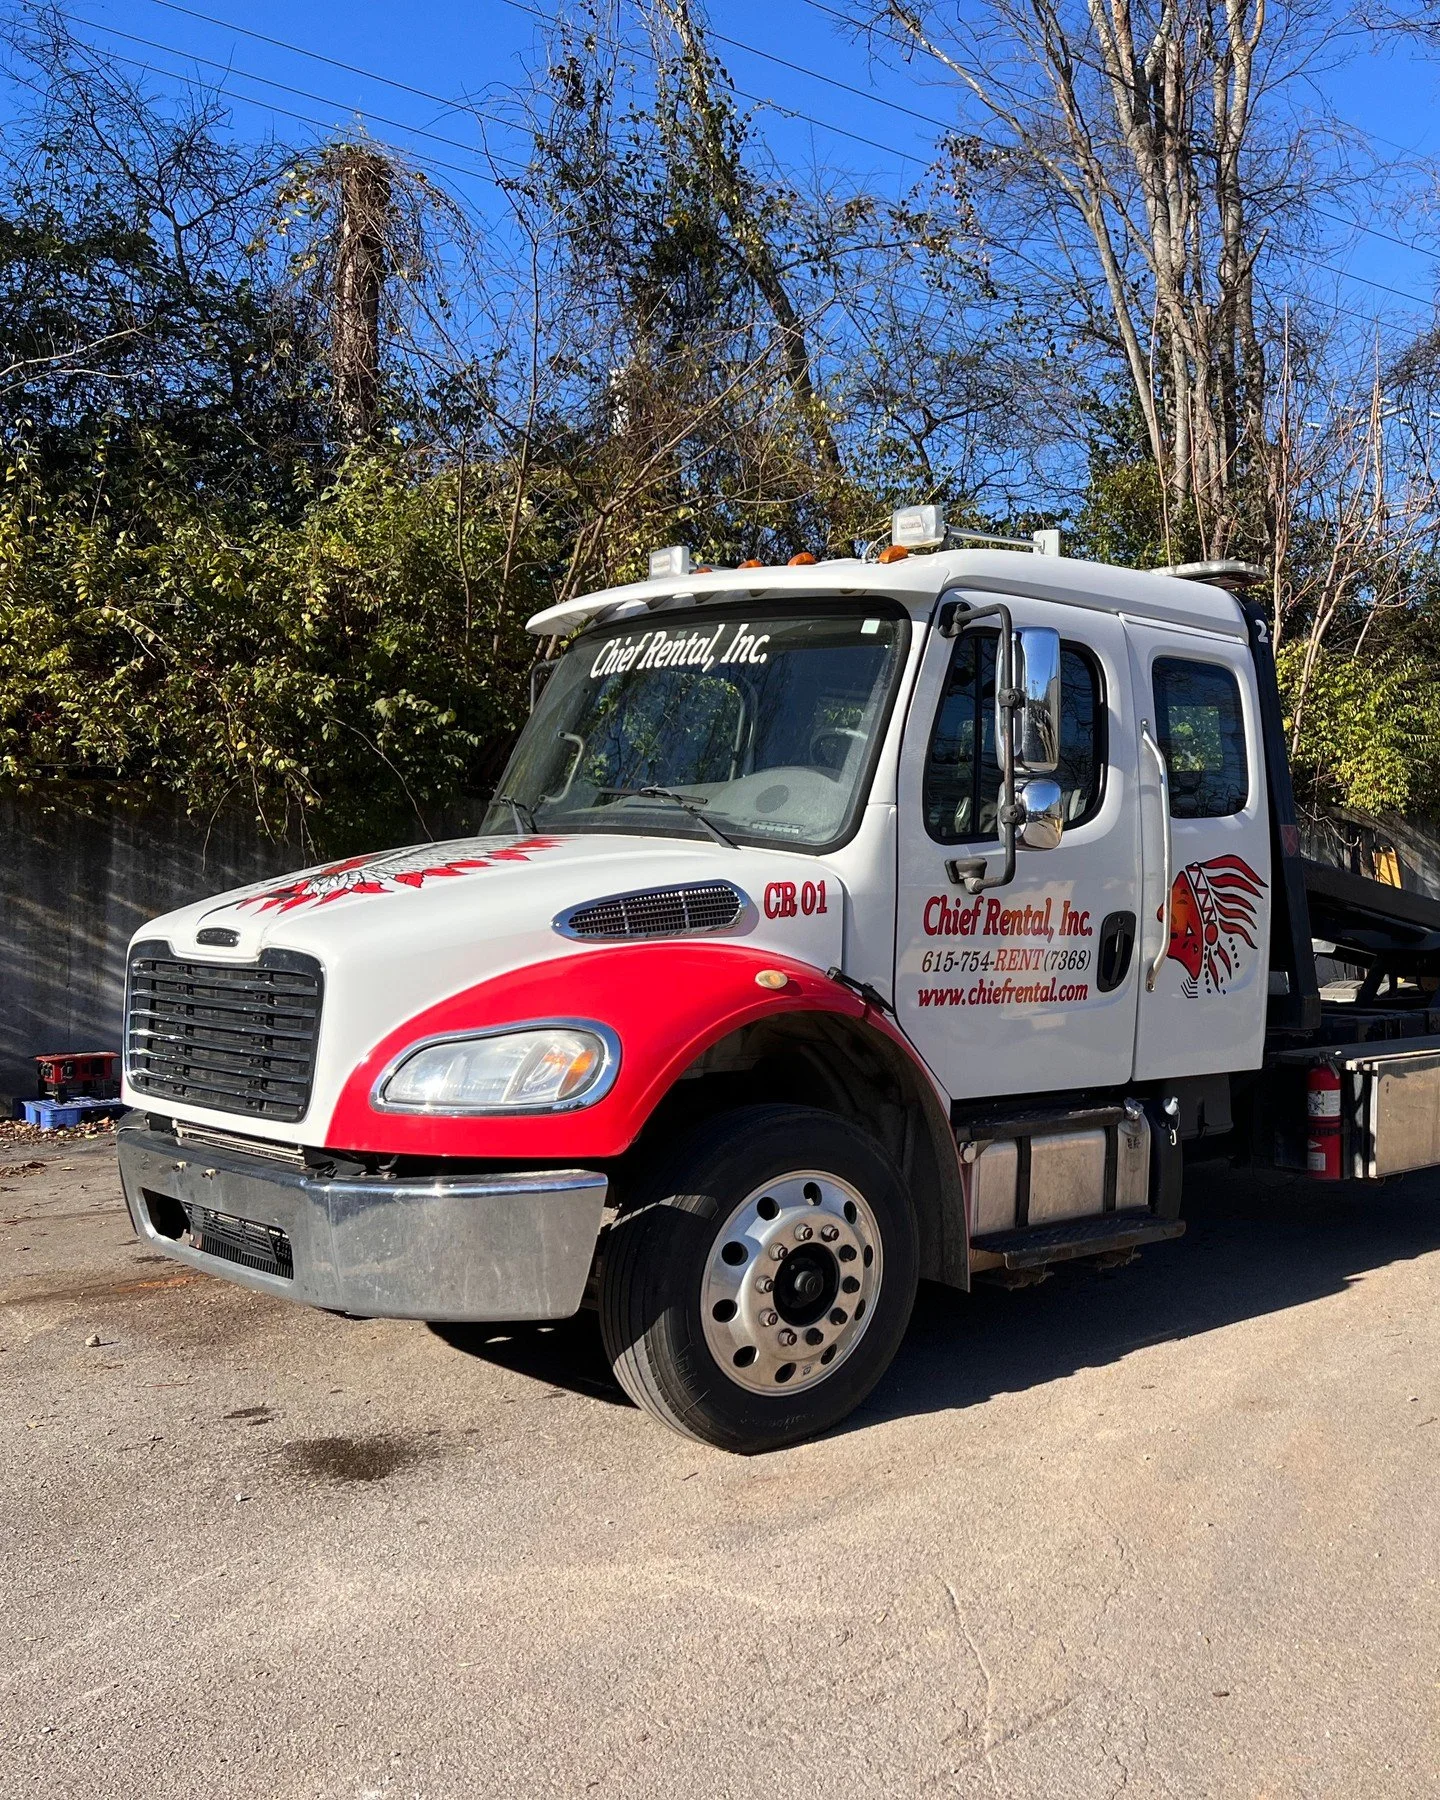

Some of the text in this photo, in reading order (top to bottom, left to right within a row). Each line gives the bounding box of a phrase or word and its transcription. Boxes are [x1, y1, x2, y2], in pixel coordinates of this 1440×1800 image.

[590, 624, 770, 678] Chief Rental, Inc.
[923, 894, 1093, 943] Chief Rental, Inc.
[918, 977, 1088, 1007] www.chiefrental.com
